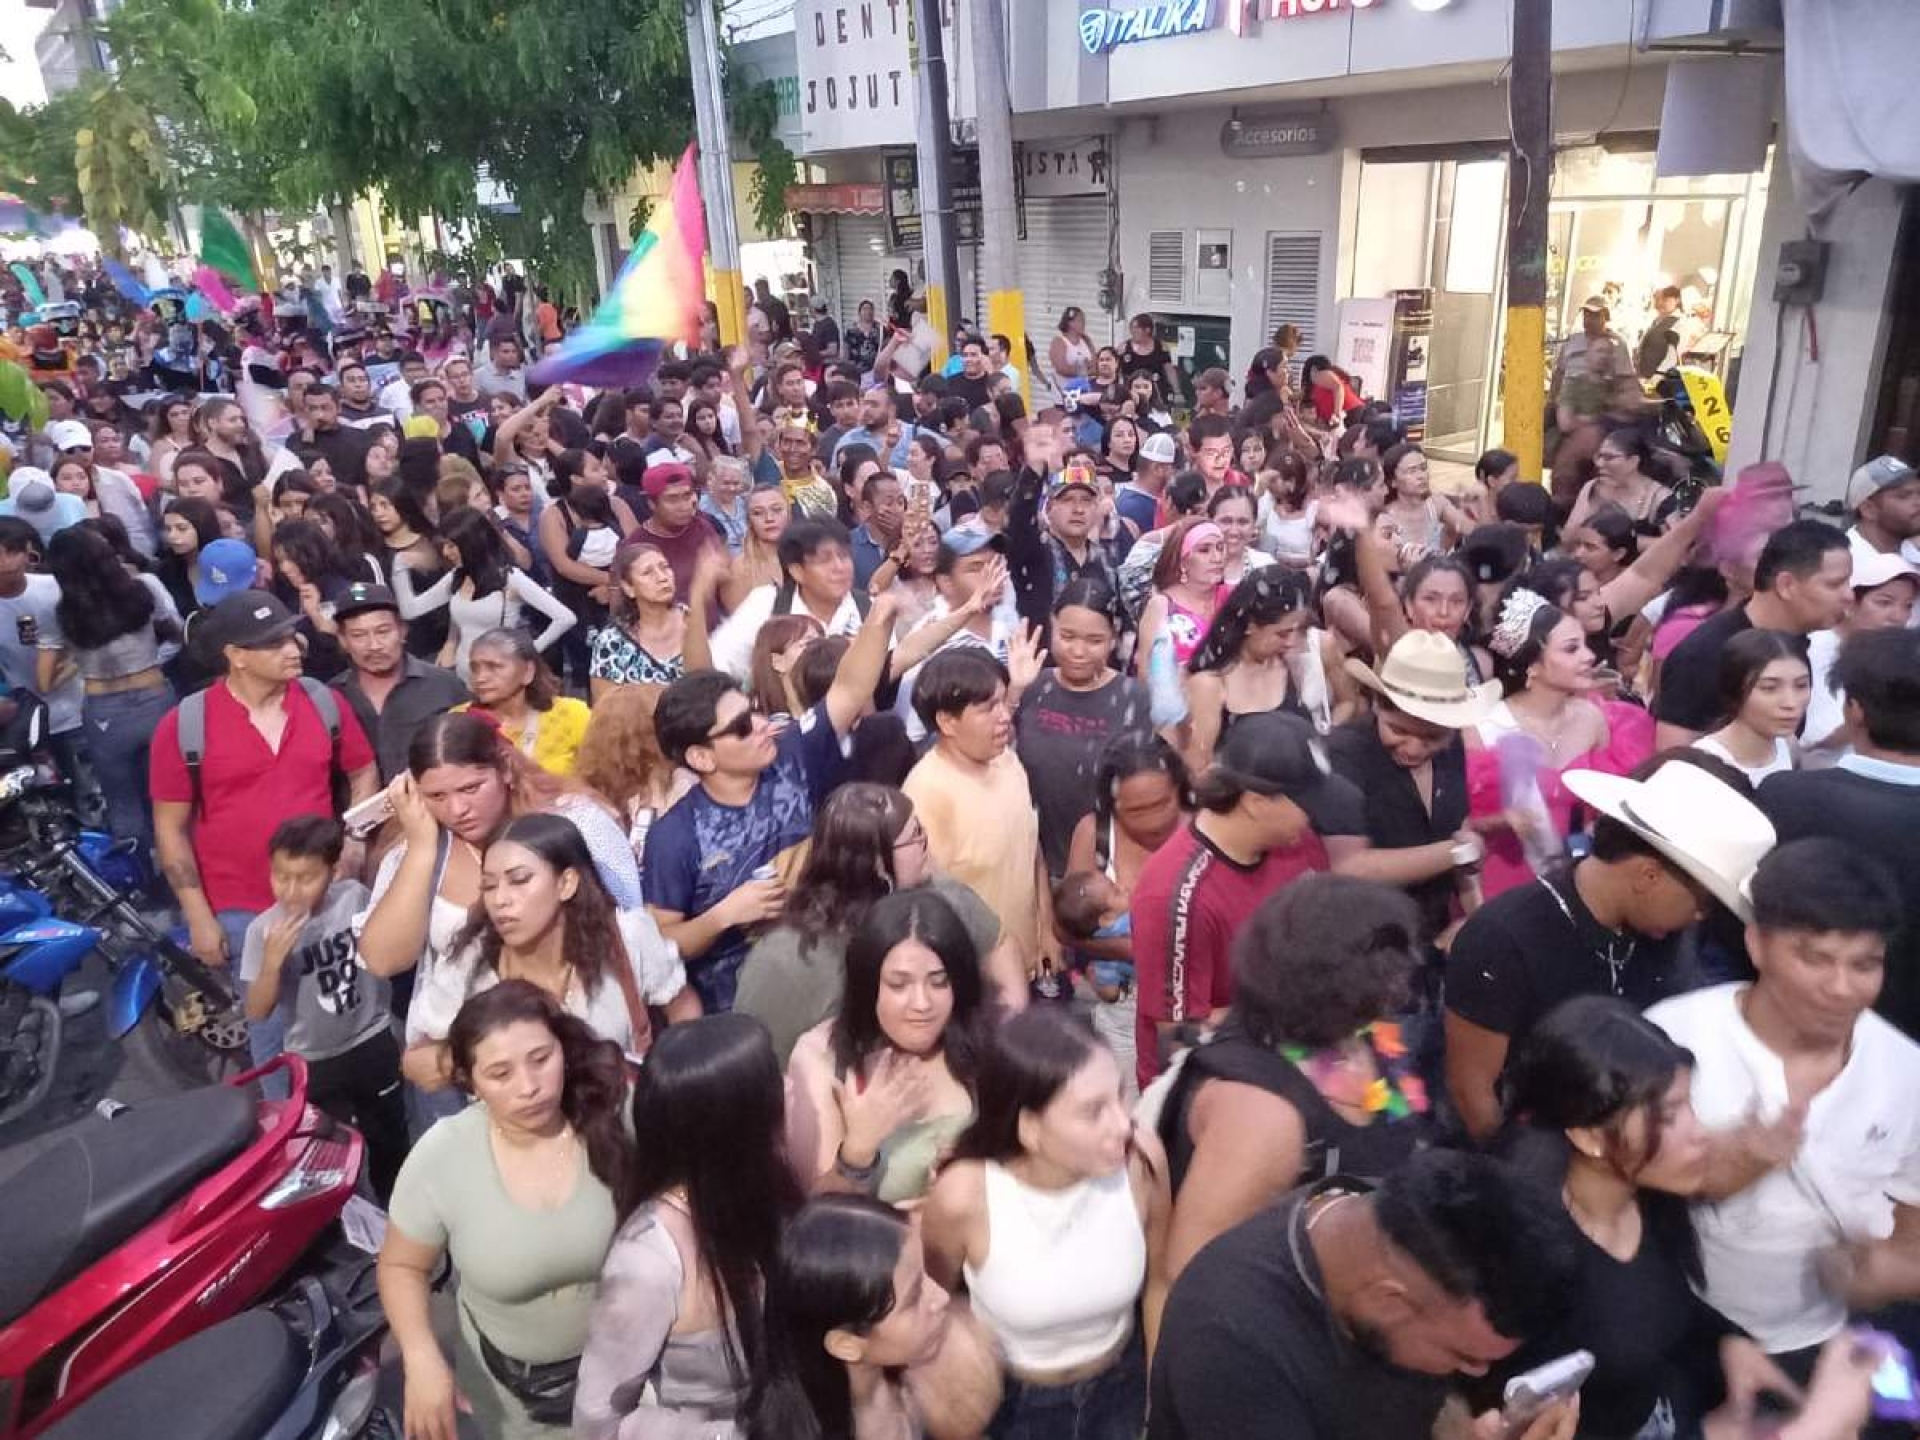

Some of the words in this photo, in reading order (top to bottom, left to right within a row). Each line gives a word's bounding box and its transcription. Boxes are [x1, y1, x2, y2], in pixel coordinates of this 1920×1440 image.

[815, 0, 951, 46] DENTL
[1104, 0, 1207, 44] ITALIKA
[807, 70, 901, 114] JOJUT
[1026, 151, 1079, 176] ISTA
[317, 960, 358, 996] DO
